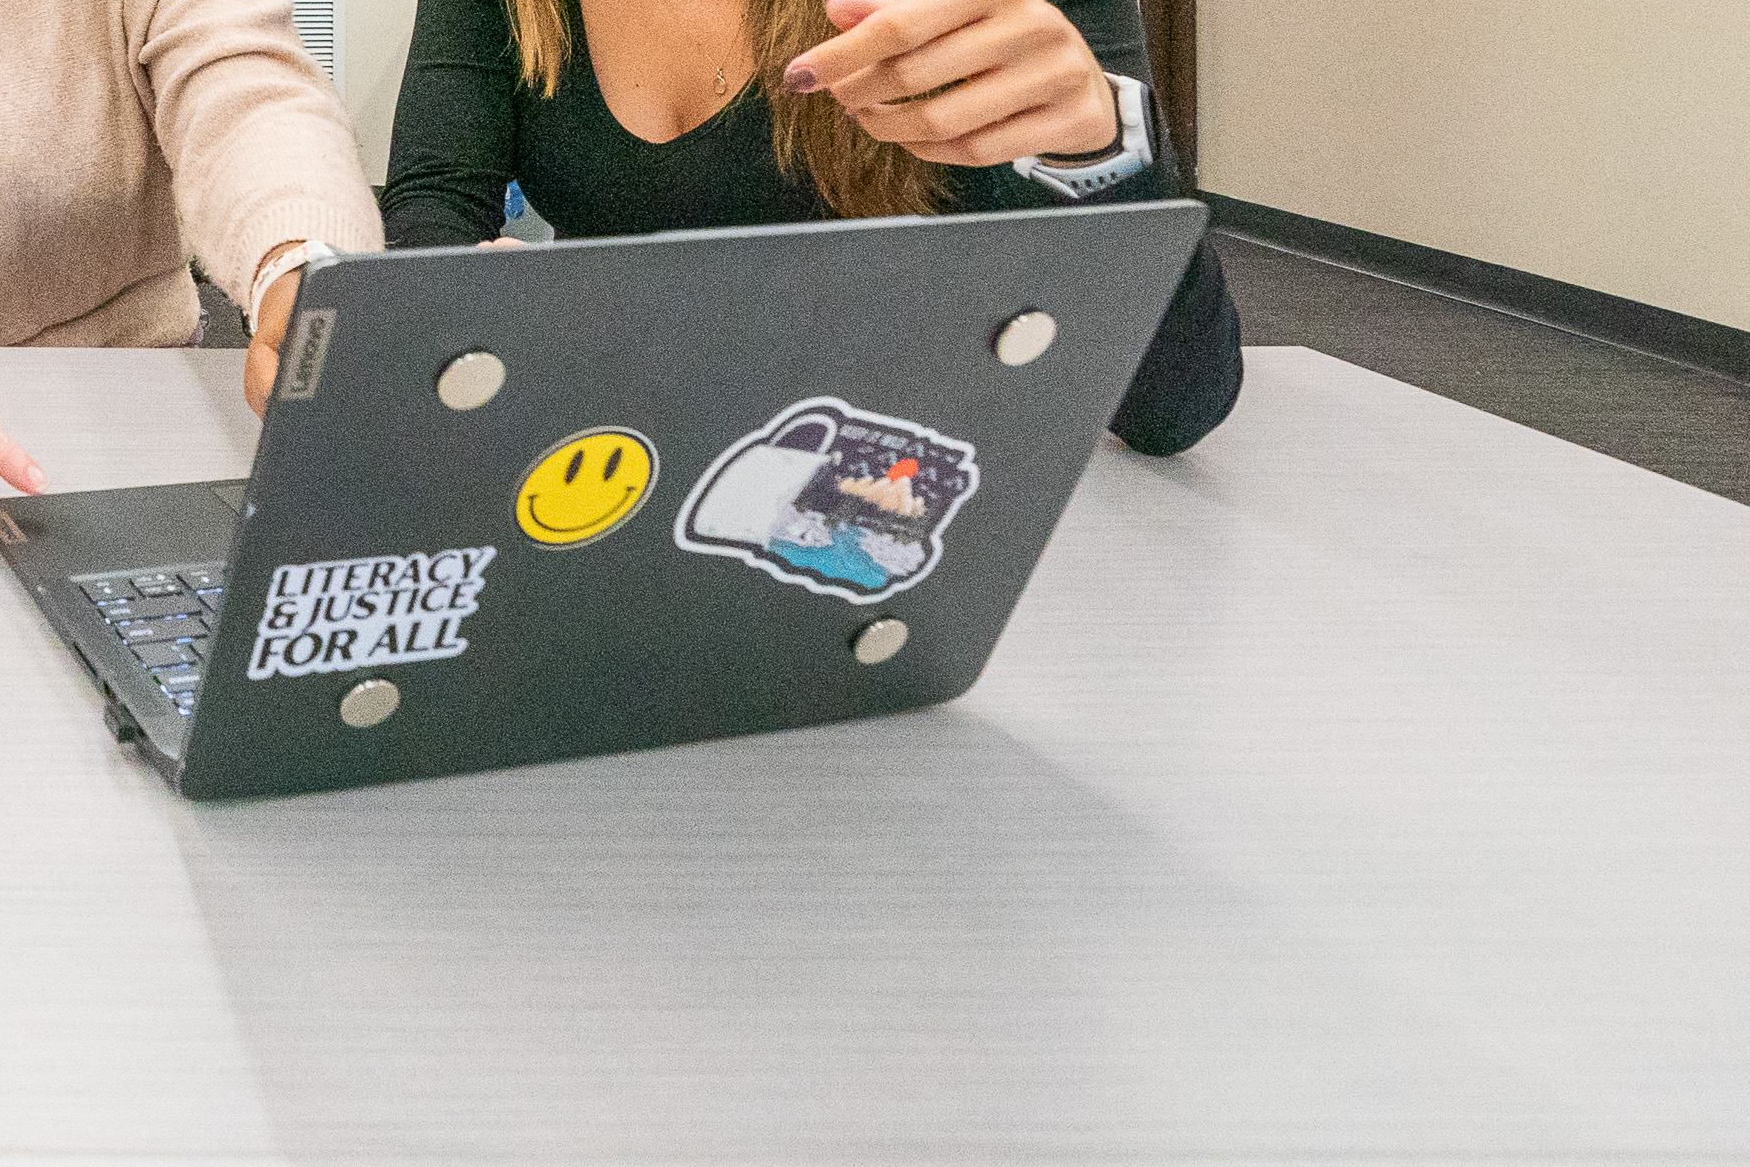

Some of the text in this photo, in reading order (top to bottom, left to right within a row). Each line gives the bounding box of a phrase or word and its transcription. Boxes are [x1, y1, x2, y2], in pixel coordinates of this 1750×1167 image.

[290, 316, 326, 394] Lenovo
[275, 552, 487, 597] LITERACY
[266, 583, 470, 634] & JUSTICE
[256, 617, 459, 670] FOR ALL
